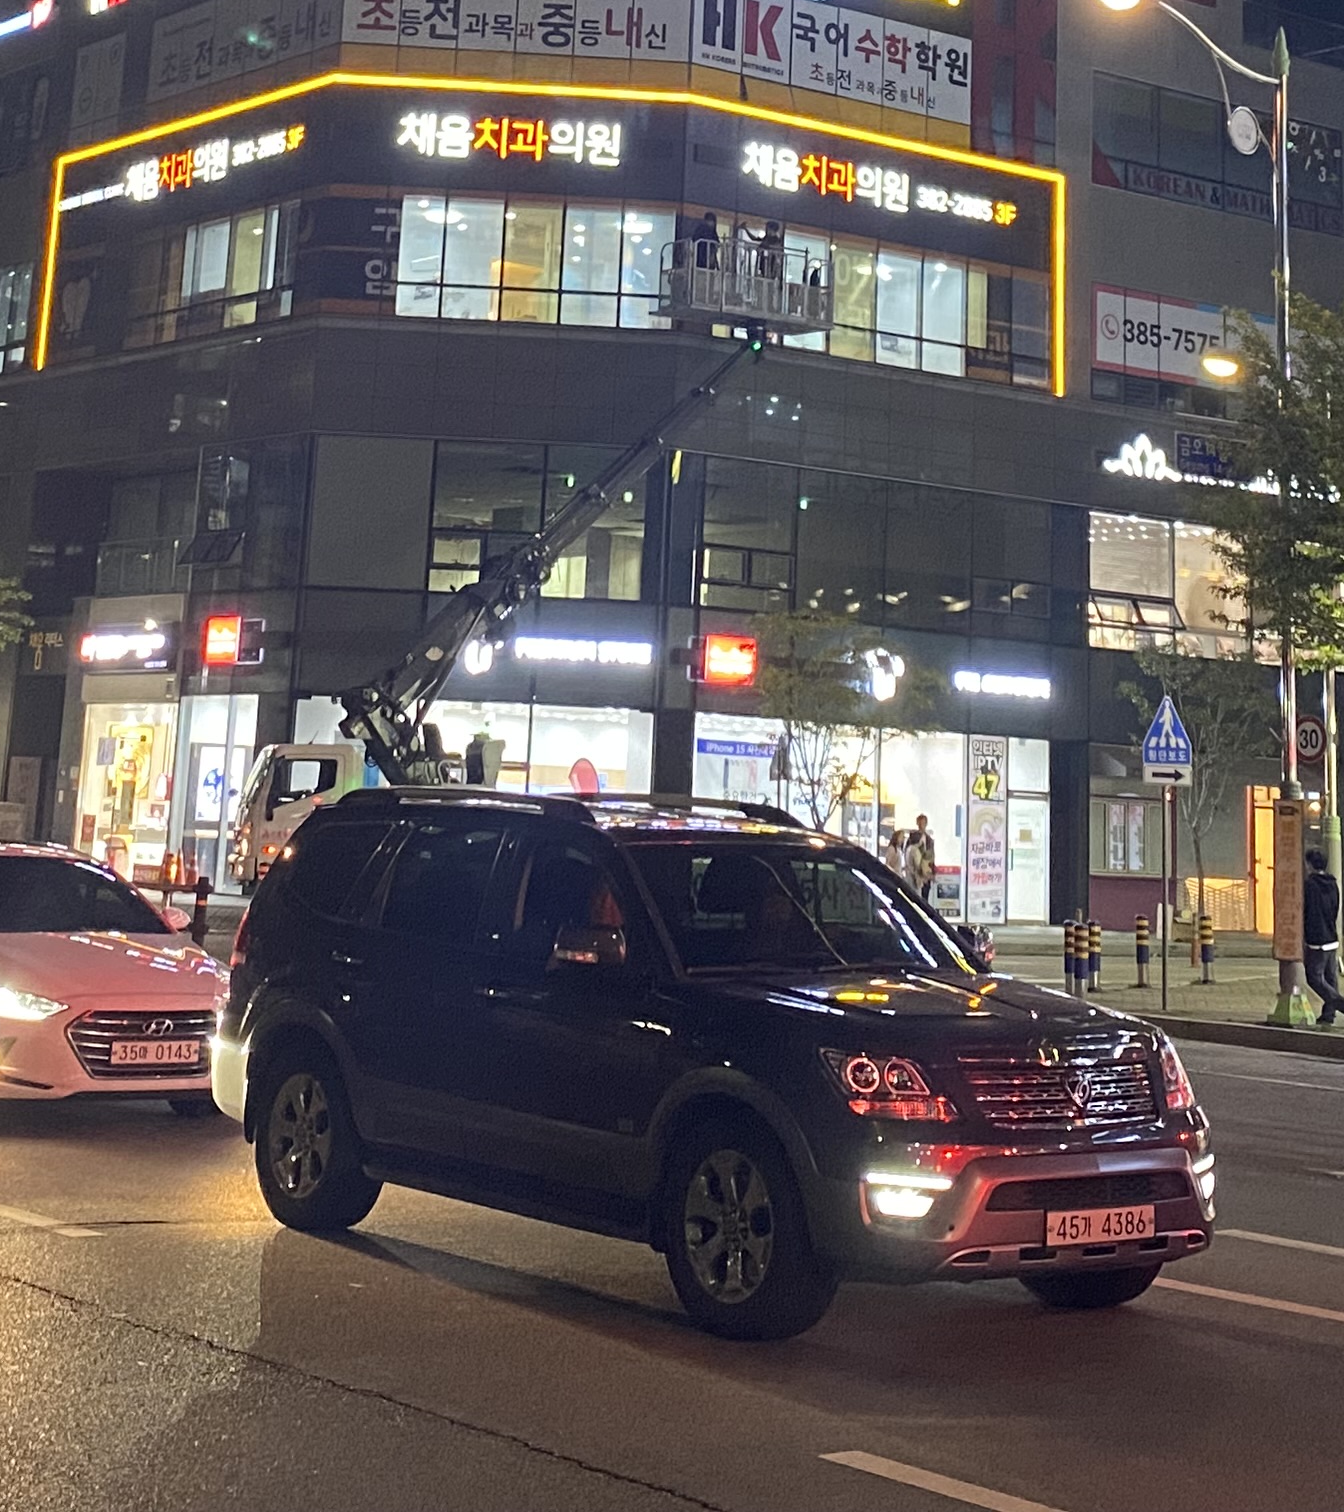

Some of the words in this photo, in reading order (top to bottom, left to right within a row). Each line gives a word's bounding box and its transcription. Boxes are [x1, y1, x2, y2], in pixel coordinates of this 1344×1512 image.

[396, 111, 622, 168] 채움치과의원
[706, 741, 735, 754] iPhone
[736, 743, 746, 754] 15
[973, 739, 1004, 757] 인터넷
[1299, 729, 1319, 750] 30
[974, 757, 1003, 772] IPTV
[972, 772, 1002, 800] 47
[155, 1043, 193, 1061] 0143
[1101, 1209, 1146, 1238] 4386
